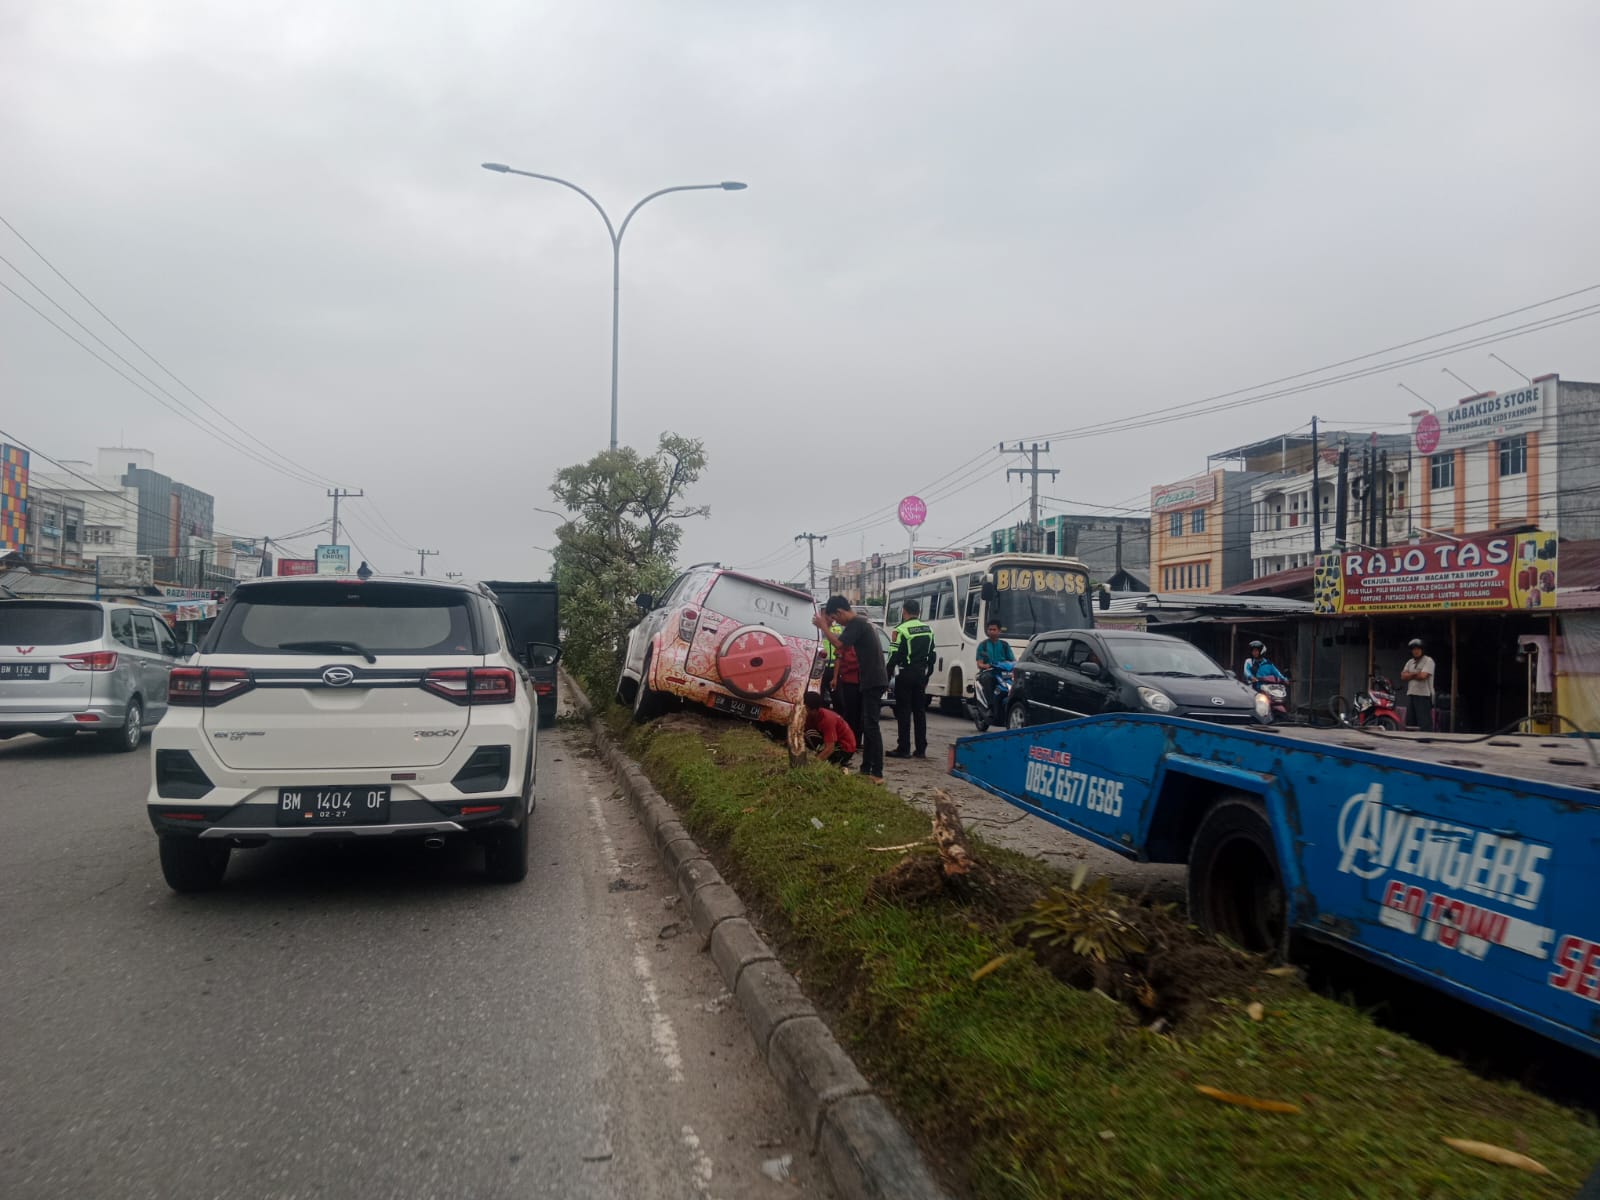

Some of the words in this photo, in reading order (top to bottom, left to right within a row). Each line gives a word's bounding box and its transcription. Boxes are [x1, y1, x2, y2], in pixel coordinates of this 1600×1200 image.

[1447, 401, 1501, 423] KABAKIDS
[1504, 387, 1540, 408] STORE
[1345, 549, 1425, 577] RAJO
[1433, 539, 1509, 568] TAS
[1466, 570, 1494, 578] IMPORT
[1029, 745, 1072, 768] HOTLINE
[282, 793, 302, 810] BM
[317, 791, 353, 810] 1404
[1025, 761, 1056, 798] 0852
[1055, 768, 1089, 806] 6577
[1087, 776, 1124, 817] 6585
